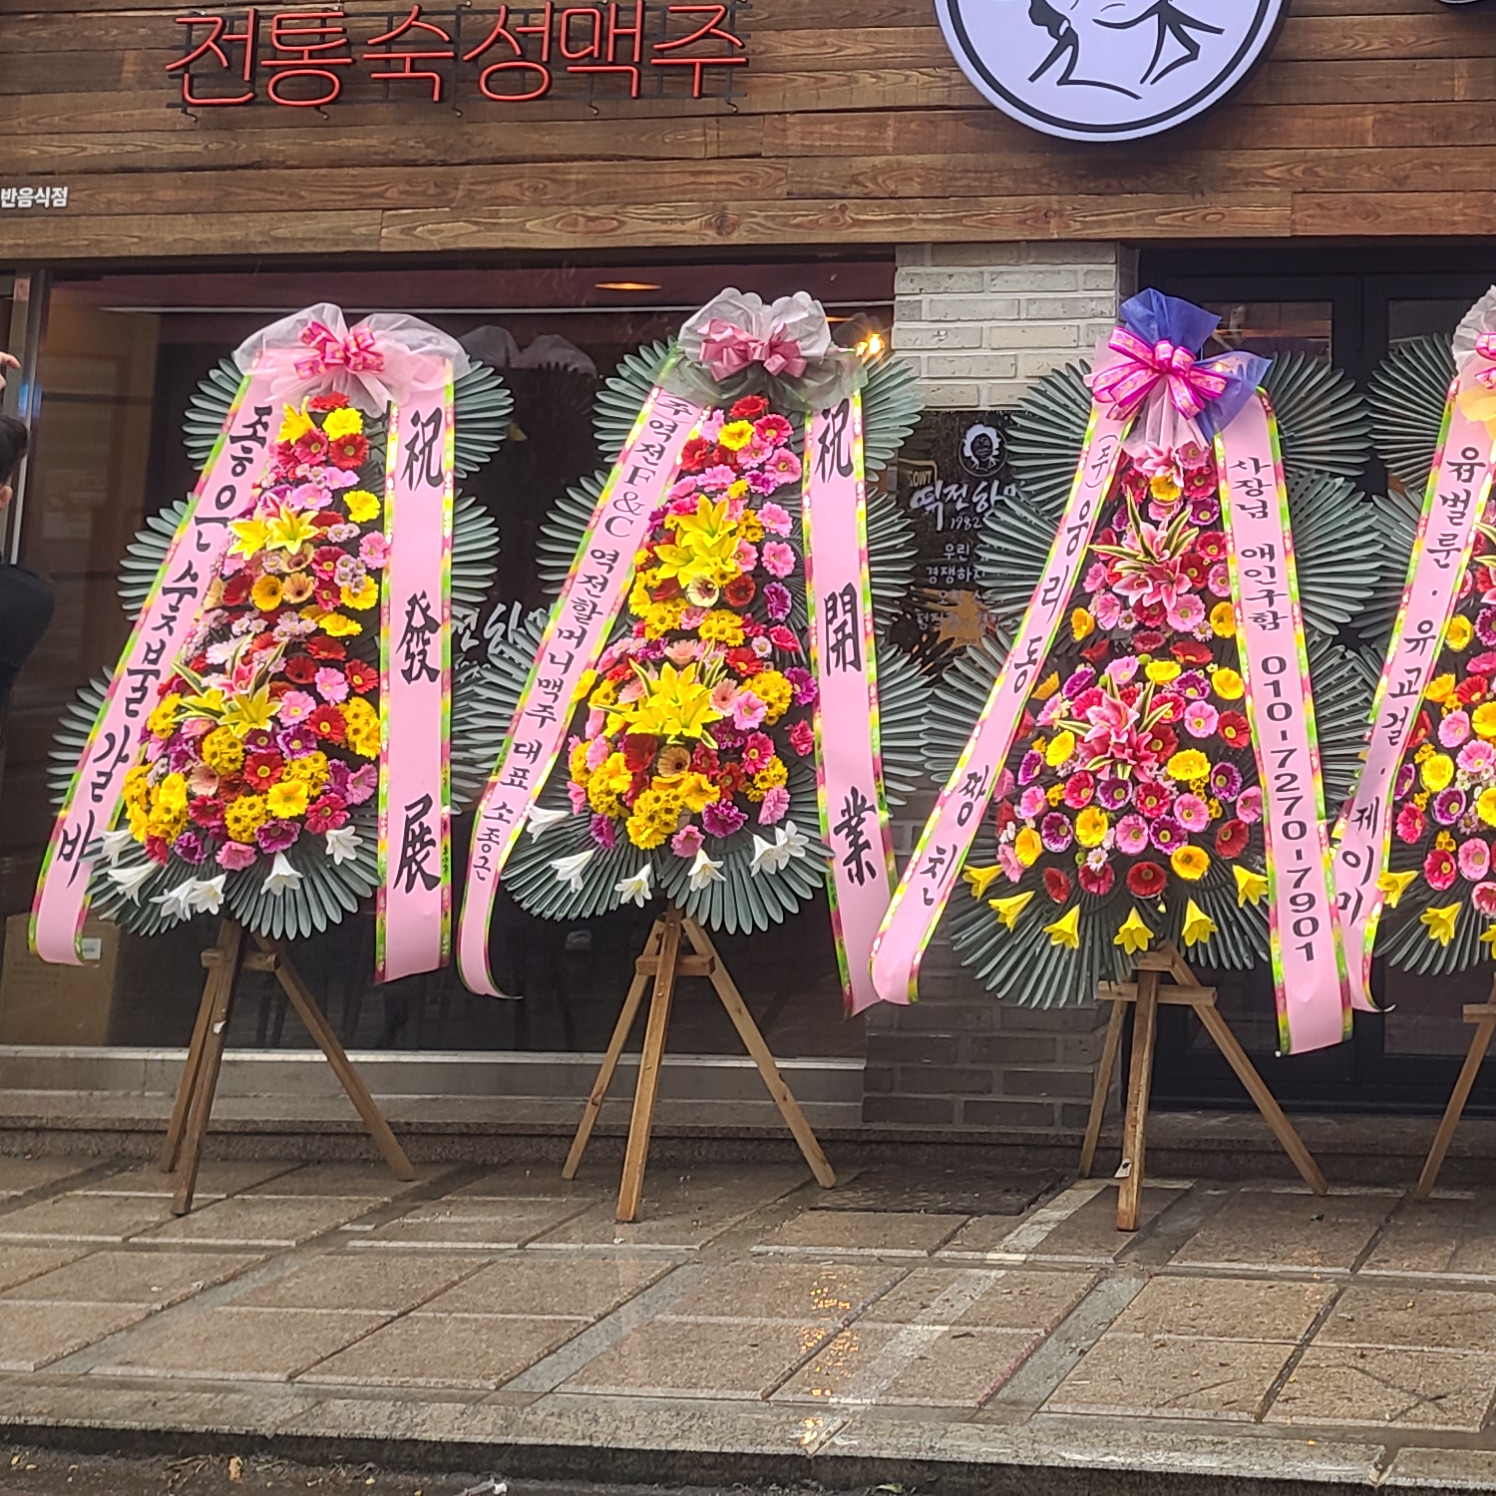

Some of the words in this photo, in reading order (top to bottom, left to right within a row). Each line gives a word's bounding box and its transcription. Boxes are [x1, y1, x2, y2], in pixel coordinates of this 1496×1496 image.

[0, 186, 69, 209] 반음식점
[1228, 456, 1273, 520] 사장님
[1240, 542, 1290, 632] 애인구함
[524, 548, 622, 730] 역전할머니맥주
[1380, 618, 1438, 747] 유교걸
[499, 738, 544, 791] 대표
[1260, 655, 1320, 963] 010-7270-7901
[472, 800, 515, 882] 소종근
[1337, 795, 1381, 928] 제이미
